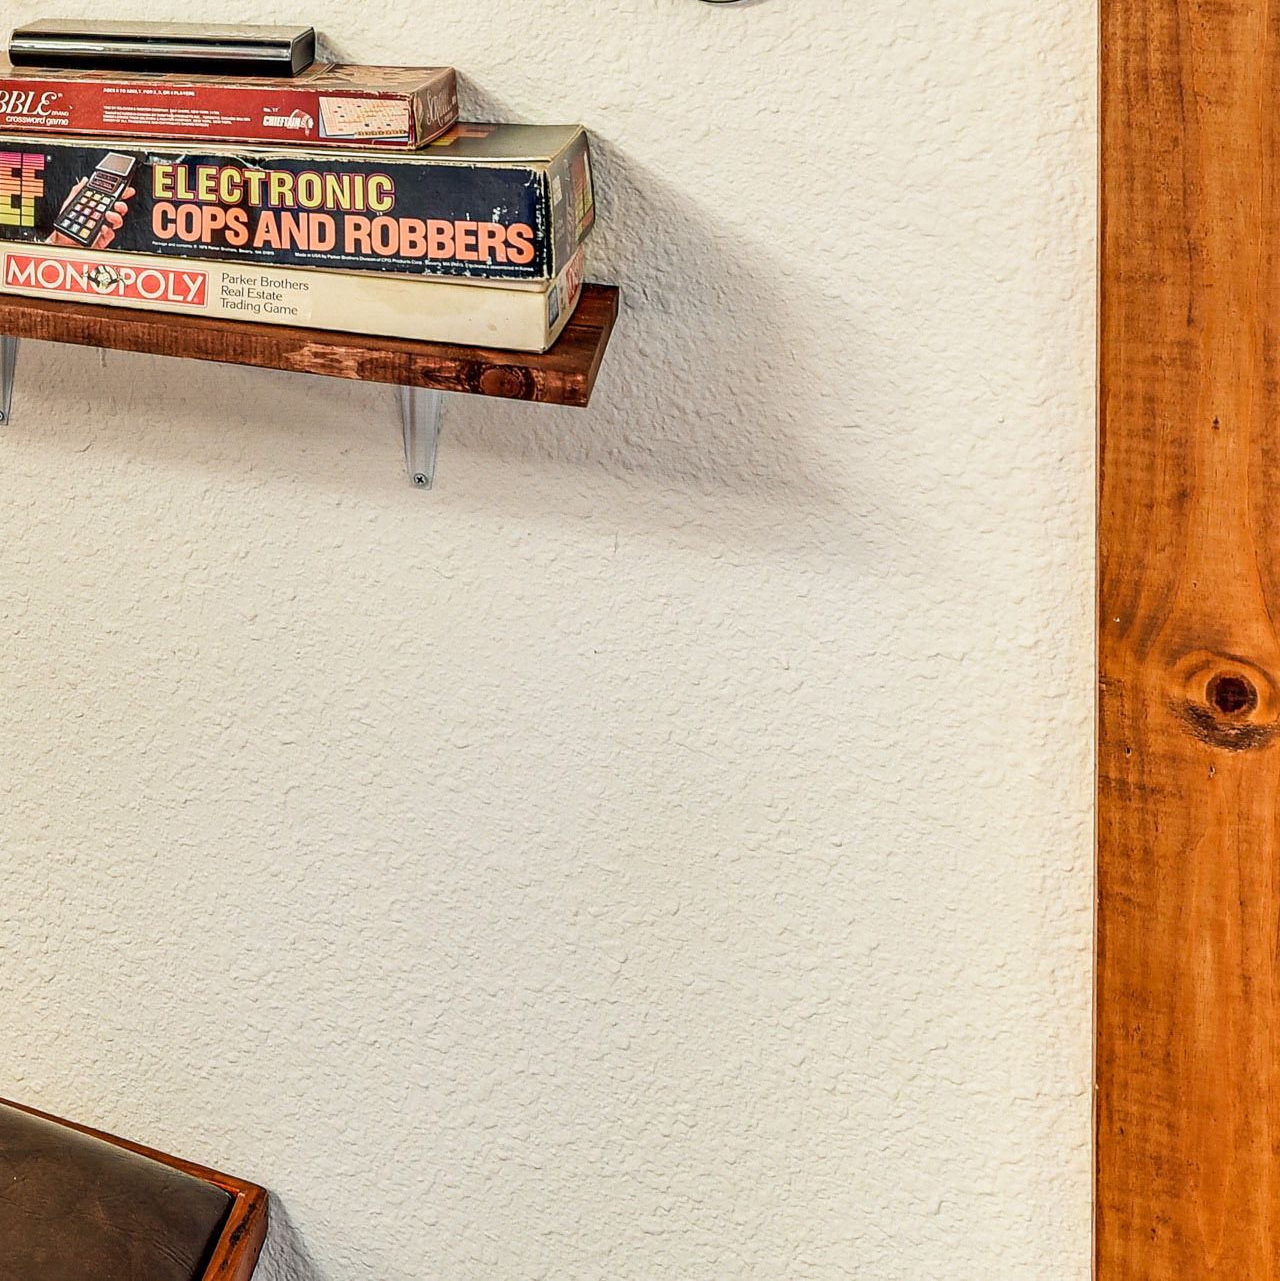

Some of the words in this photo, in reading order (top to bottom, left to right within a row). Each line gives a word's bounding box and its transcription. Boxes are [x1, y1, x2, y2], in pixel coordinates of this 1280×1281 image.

[6, 115, 45, 124] crossword
[46, 117, 69, 126] game
[152, 164, 395, 213] ELECTRONIC
[152, 203, 248, 248] COPS
[253, 210, 335, 252] AND
[344, 214, 535, 265] ROBBERS
[7, 257, 204, 302] MONOPOLY
[221, 273, 257, 286] Parker
[260, 276, 310, 291] Brothers
[221, 286, 244, 298] Real
[247, 288, 282, 301] Estate
[220, 298, 262, 313] Trading
[263, 301, 298, 316] Game
